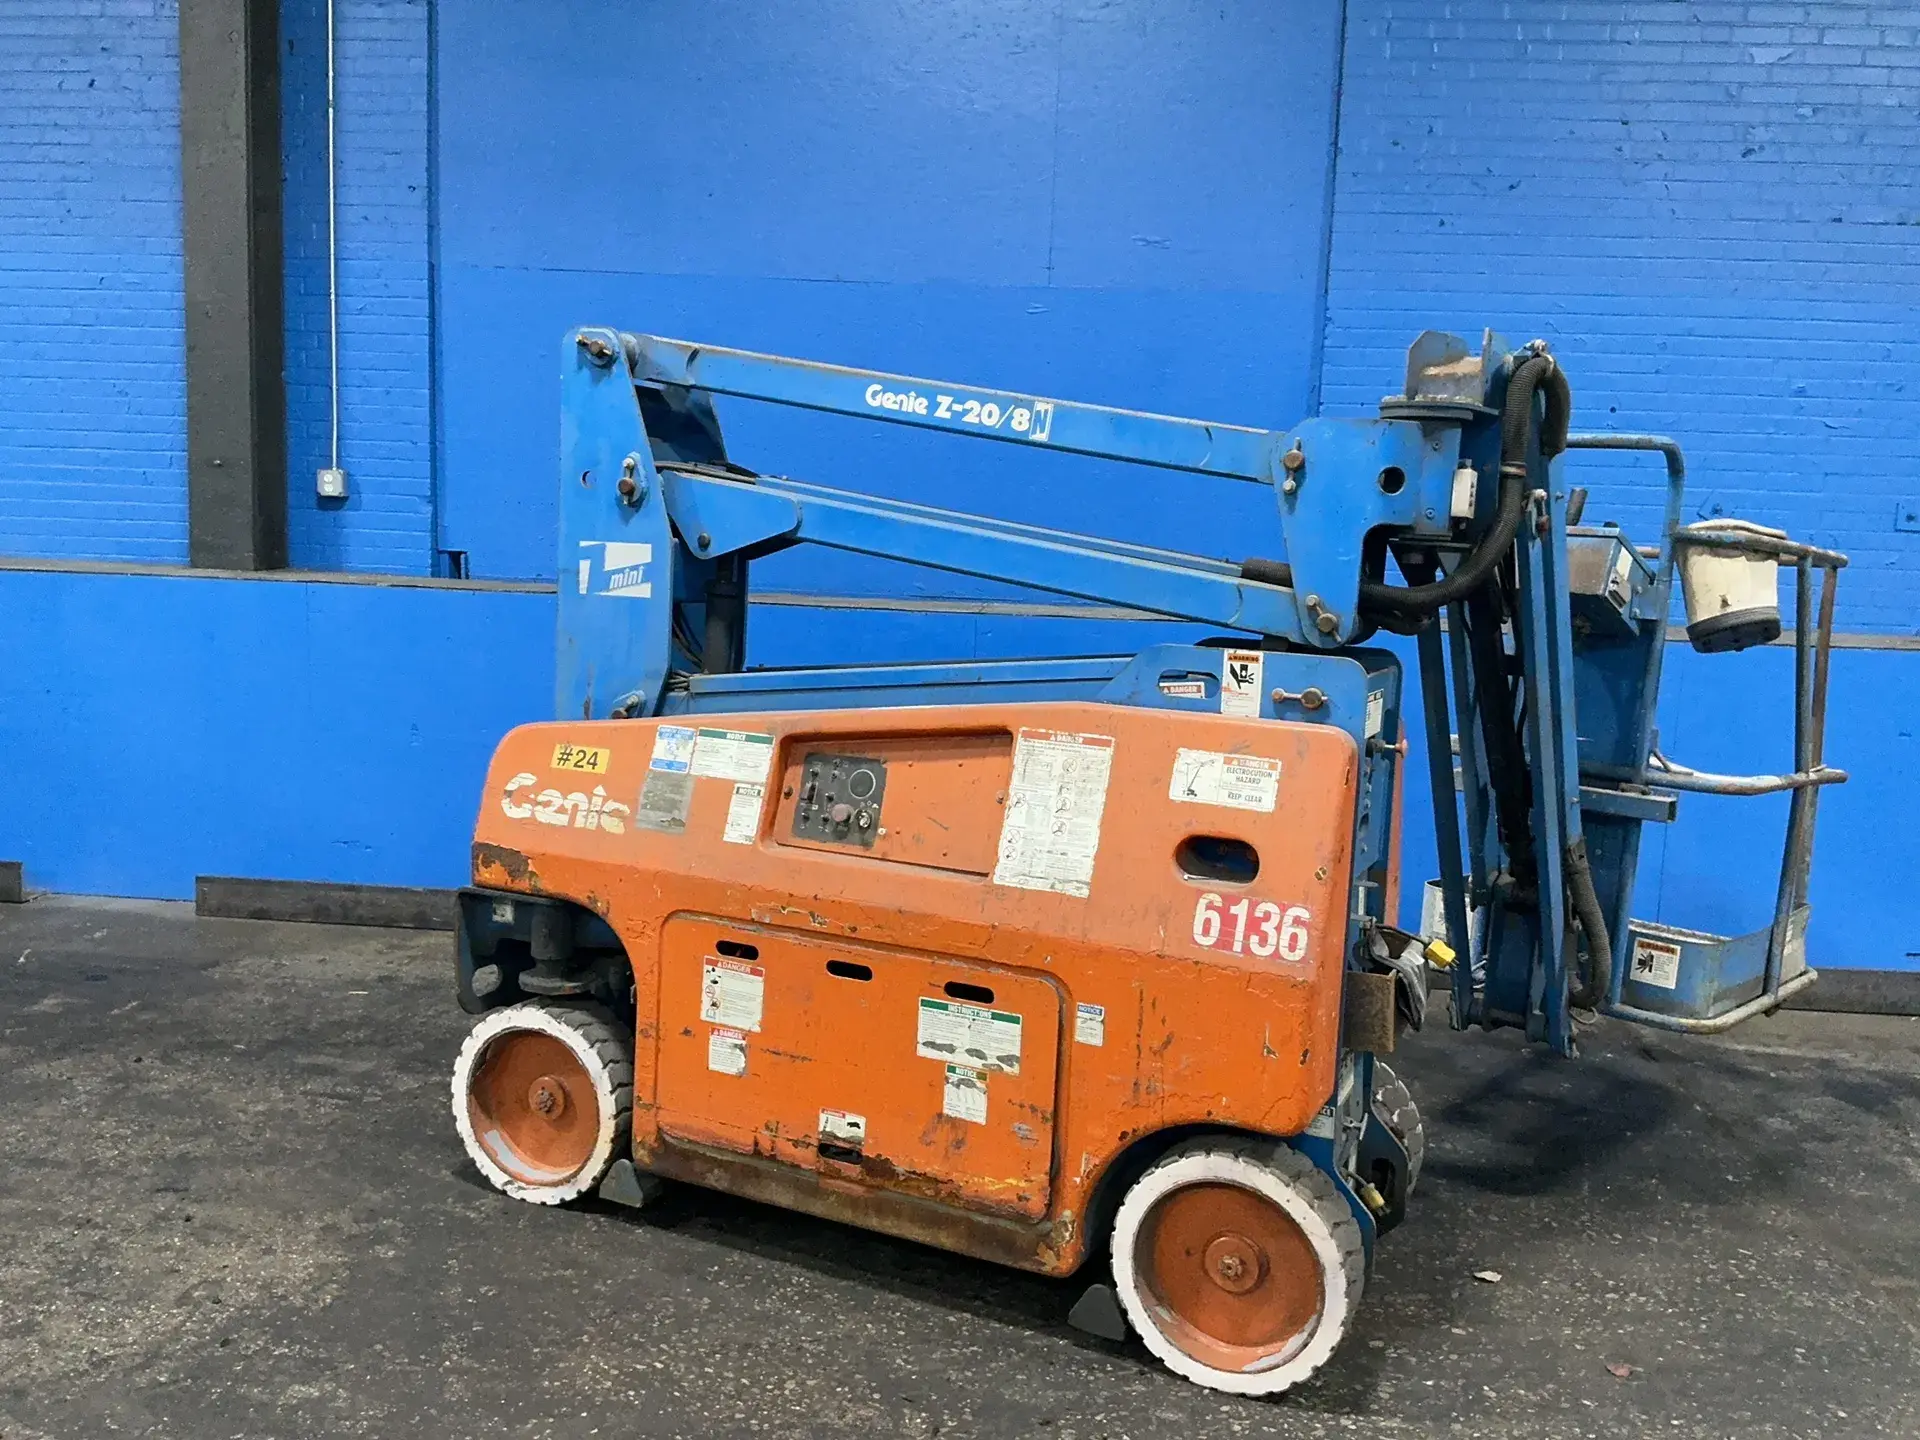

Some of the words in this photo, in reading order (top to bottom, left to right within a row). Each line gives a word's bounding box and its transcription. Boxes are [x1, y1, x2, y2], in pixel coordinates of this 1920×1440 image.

[865, 384, 928, 415] Genie
[609, 565, 645, 590] mini
[1232, 655, 1259, 663] WARNING
[1170, 685, 1198, 693] DANGER
[557, 746, 598, 770] #24
[1226, 766, 1273, 779] ELECTROCUTION
[1235, 775, 1262, 785] HAZARD
[1227, 790, 1242, 801] KEEP
[1244, 794, 1263, 803] CLEAR
[1193, 893, 1311, 961] 6136
[721, 961, 751, 974] DANGER
[947, 1004, 993, 1019] INSTRUCTIONS
[955, 1067, 977, 1079] NOTICE
